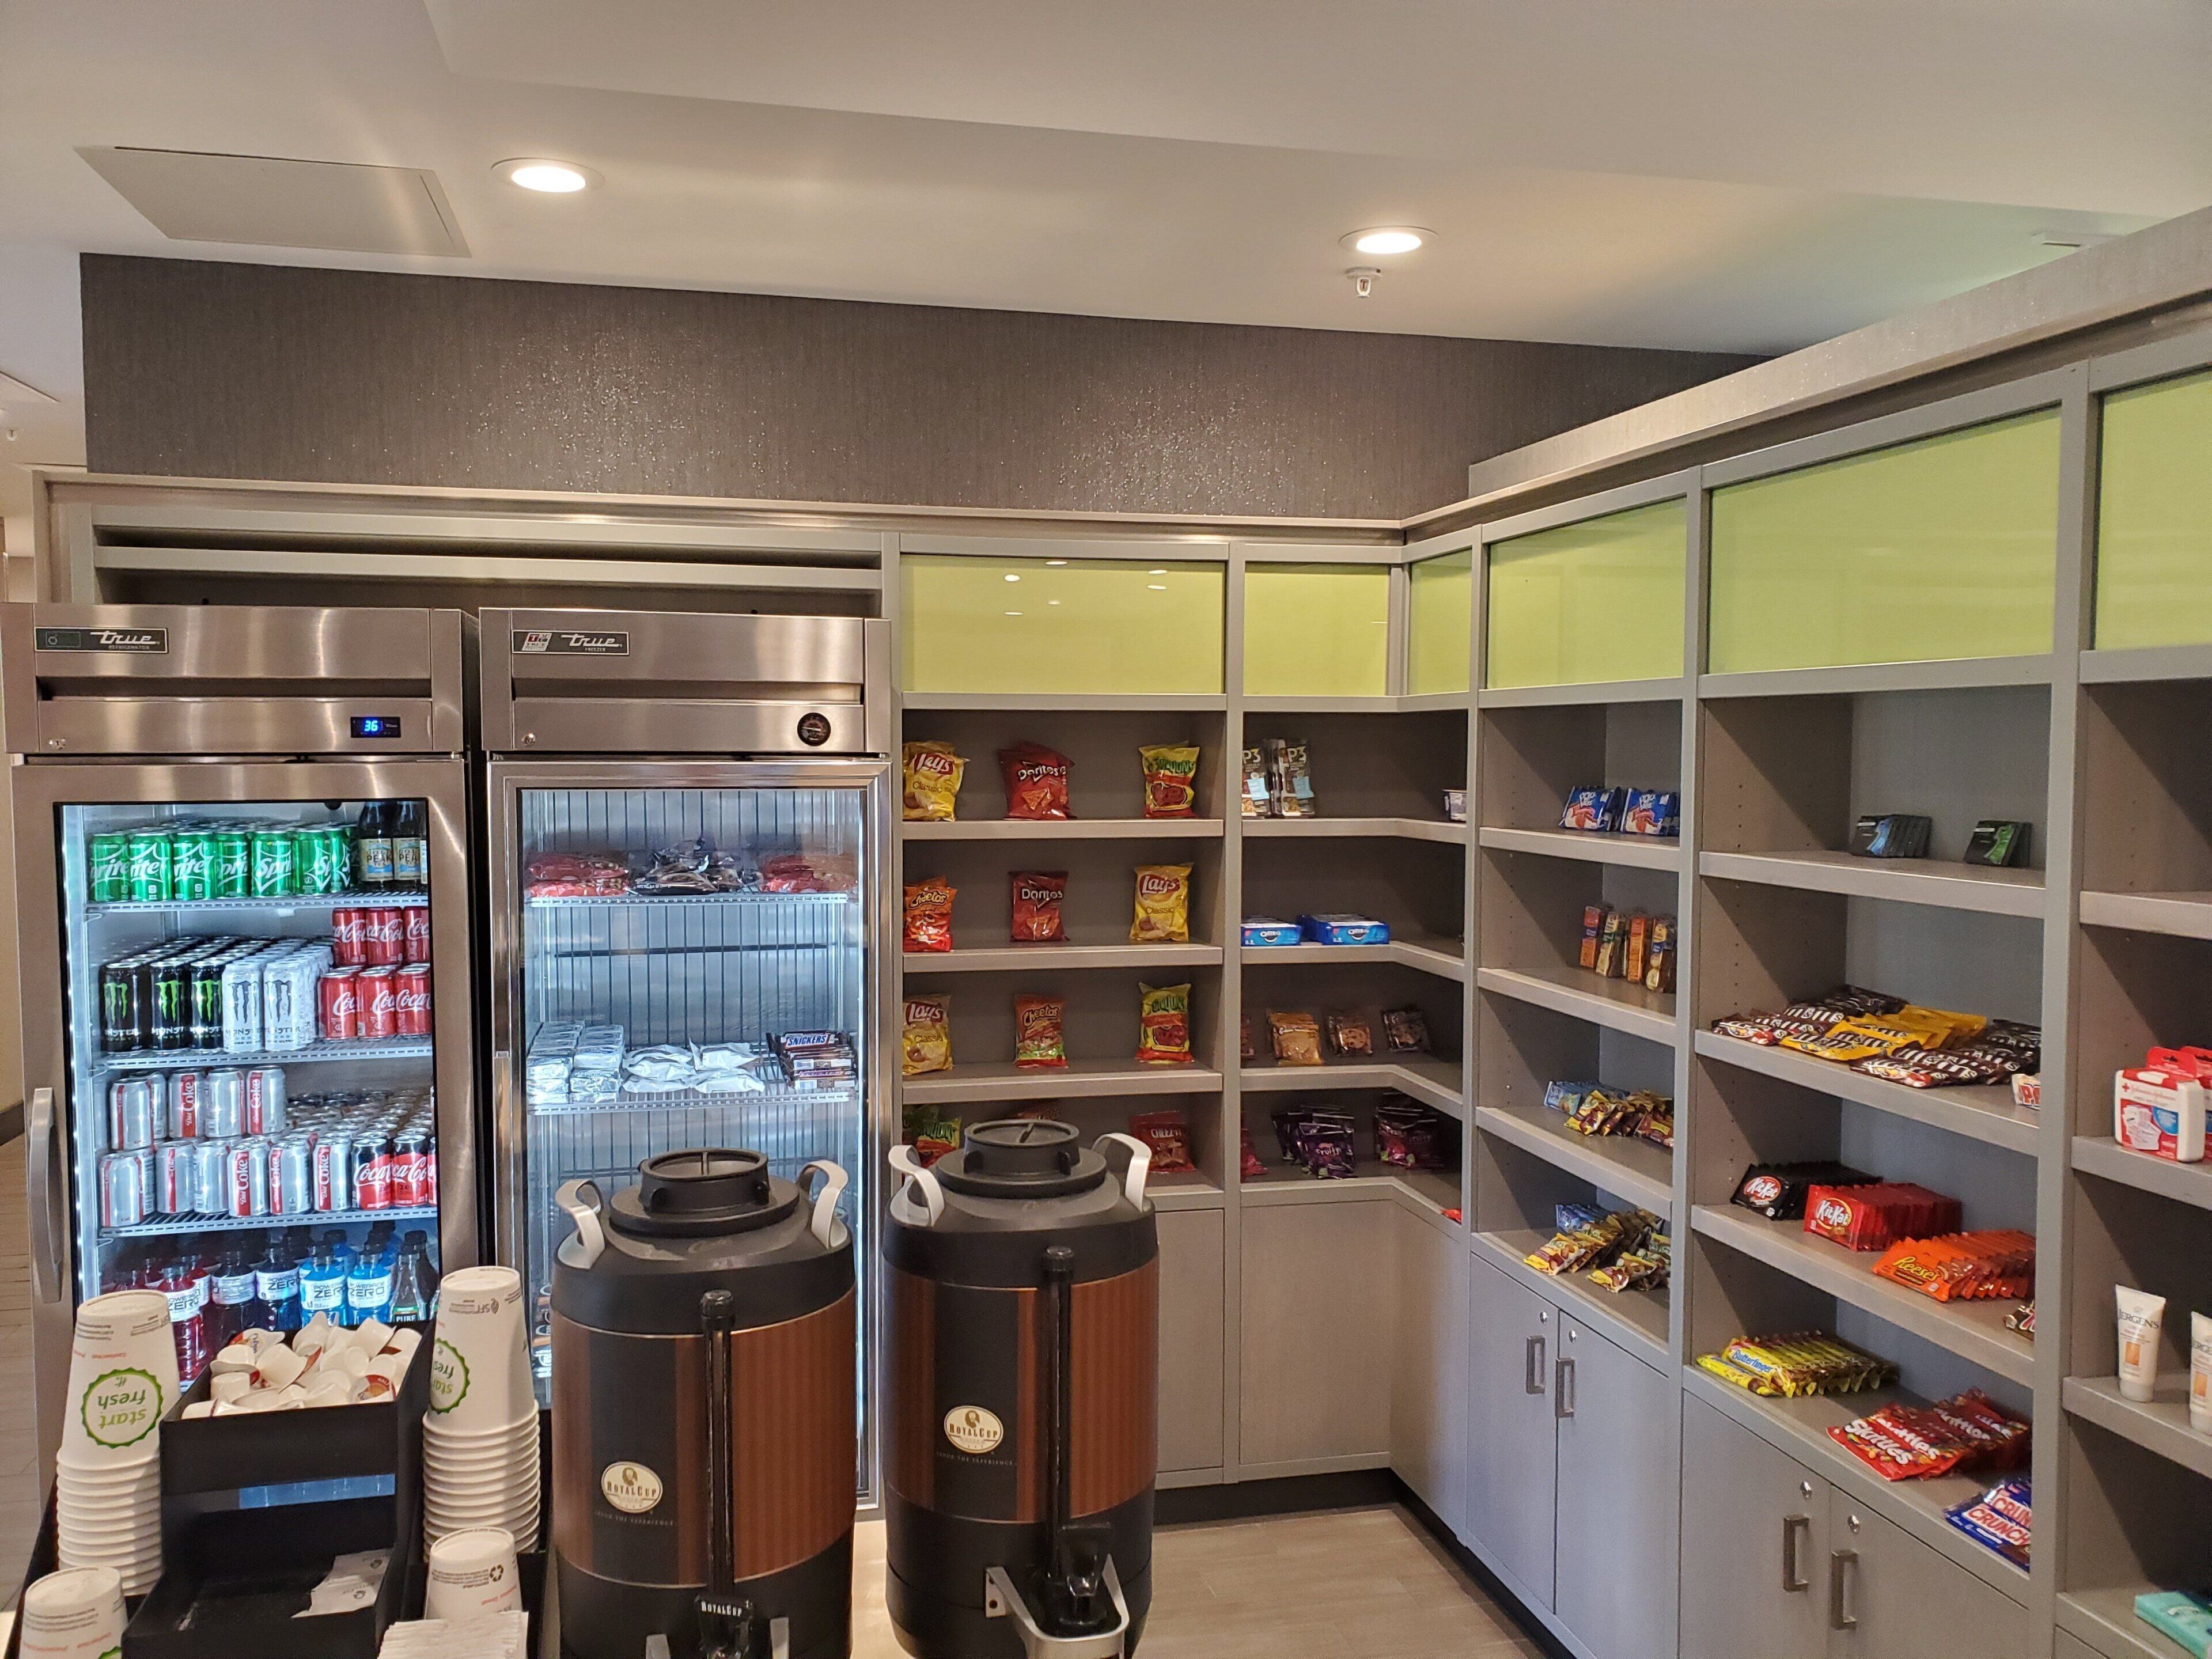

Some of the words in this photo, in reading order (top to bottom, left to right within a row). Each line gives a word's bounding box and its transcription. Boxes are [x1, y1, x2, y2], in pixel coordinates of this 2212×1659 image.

[364, 720, 378, 732] 36
[1243, 748, 1261, 764] P3
[1287, 747, 1306, 763] P3
[1018, 764, 1059, 781] Doritos
[912, 781, 942, 793] Classic
[131, 858, 160, 878] rite
[174, 857, 205, 877] rite
[1022, 889, 1063, 900] Doritos
[1146, 906, 1174, 915] Classic
[1023, 1007, 1059, 1027] Cheetos
[787, 1035, 827, 1046] SNICKERS
[183, 1081, 195, 1112] Coke
[237, 1159, 249, 1190] Coke
[1892, 1256, 1941, 1281] Reese's
[2119, 1308, 2159, 1329] JERGENS
[433, 1361, 454, 1378] fres
[1732, 1349, 1773, 1373] Butterfinger
[433, 1378, 453, 1395] star
[97, 1389, 146, 1410] fresh
[99, 1408, 147, 1429] start
[1993, 1497, 2031, 1528] CRUN
[701, 1601, 726, 1615] ROYAL
[726, 1604, 742, 1617] CUP
